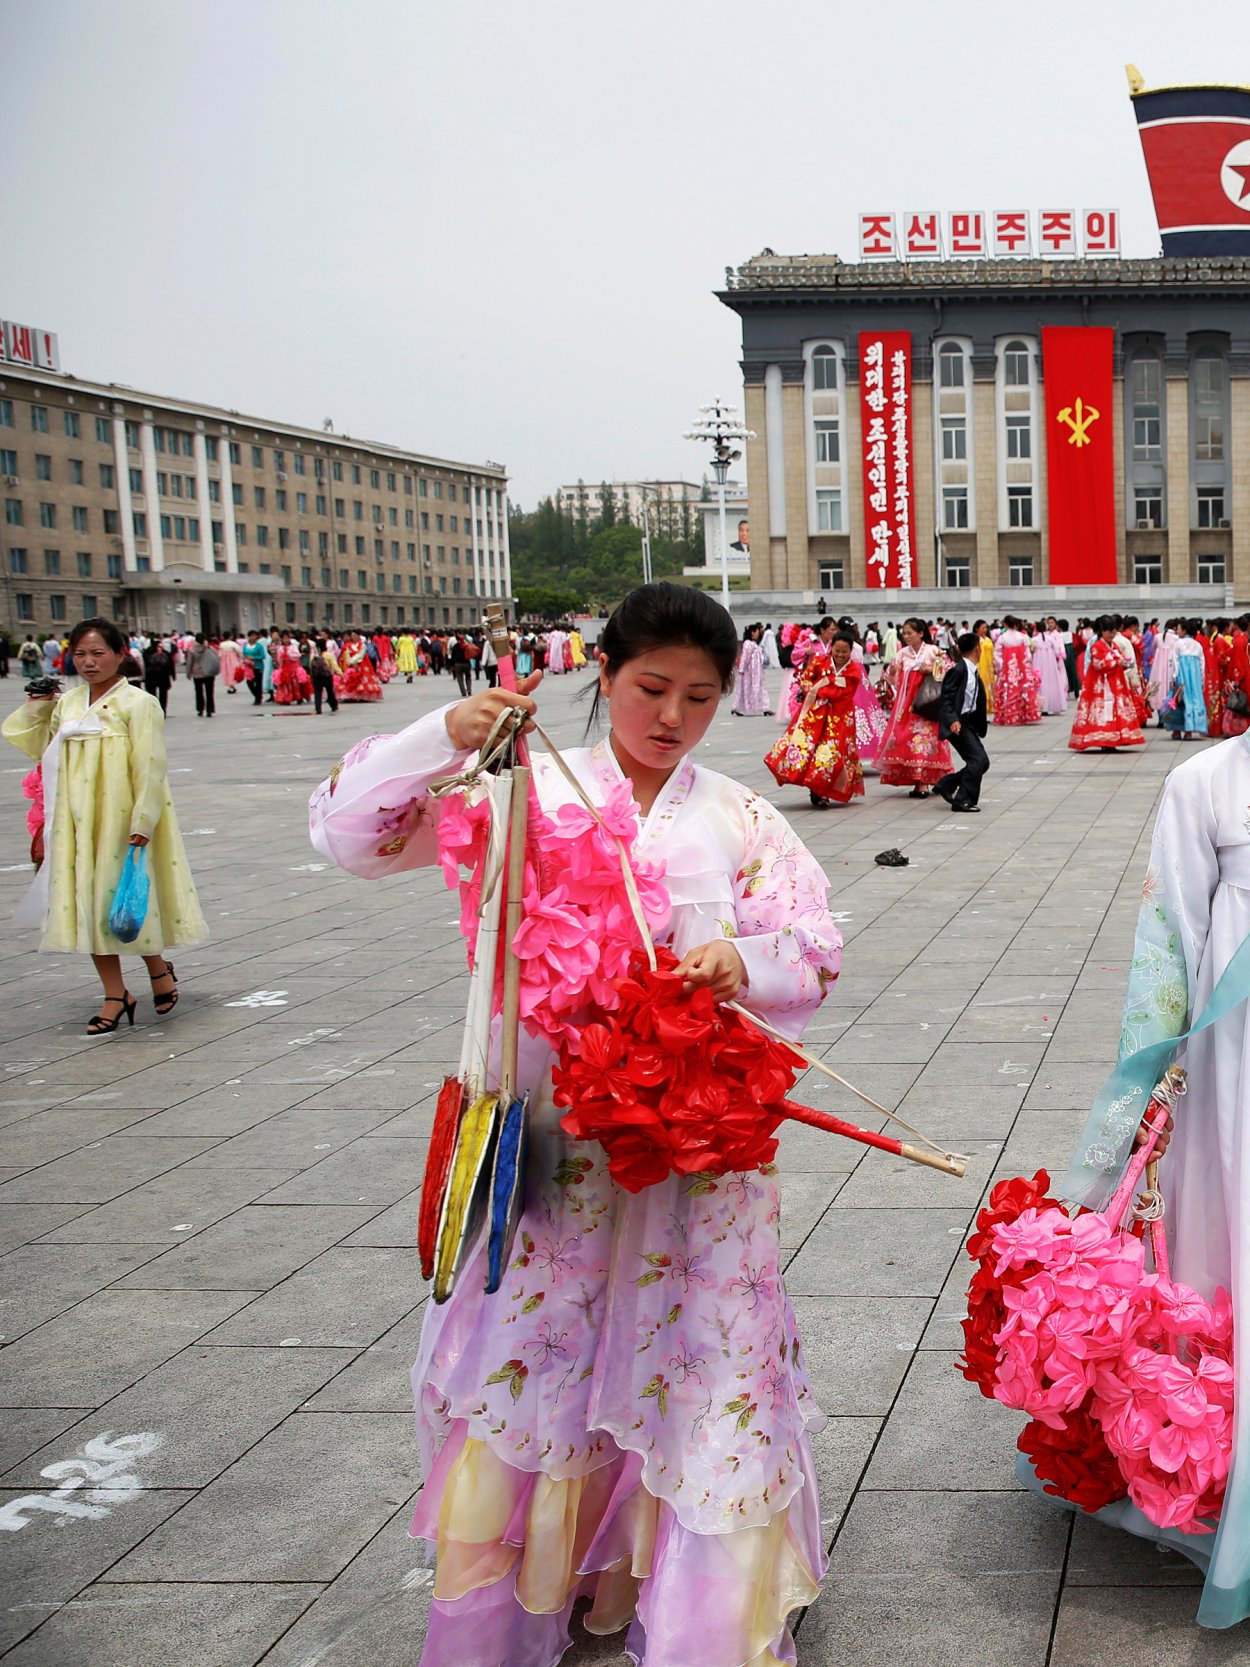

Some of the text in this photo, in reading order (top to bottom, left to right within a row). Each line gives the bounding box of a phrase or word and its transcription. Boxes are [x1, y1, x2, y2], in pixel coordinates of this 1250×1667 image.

[862, 211, 1116, 253] 조선민주주의
[864, 341, 893, 588] 위대한 조선인민 만세!
